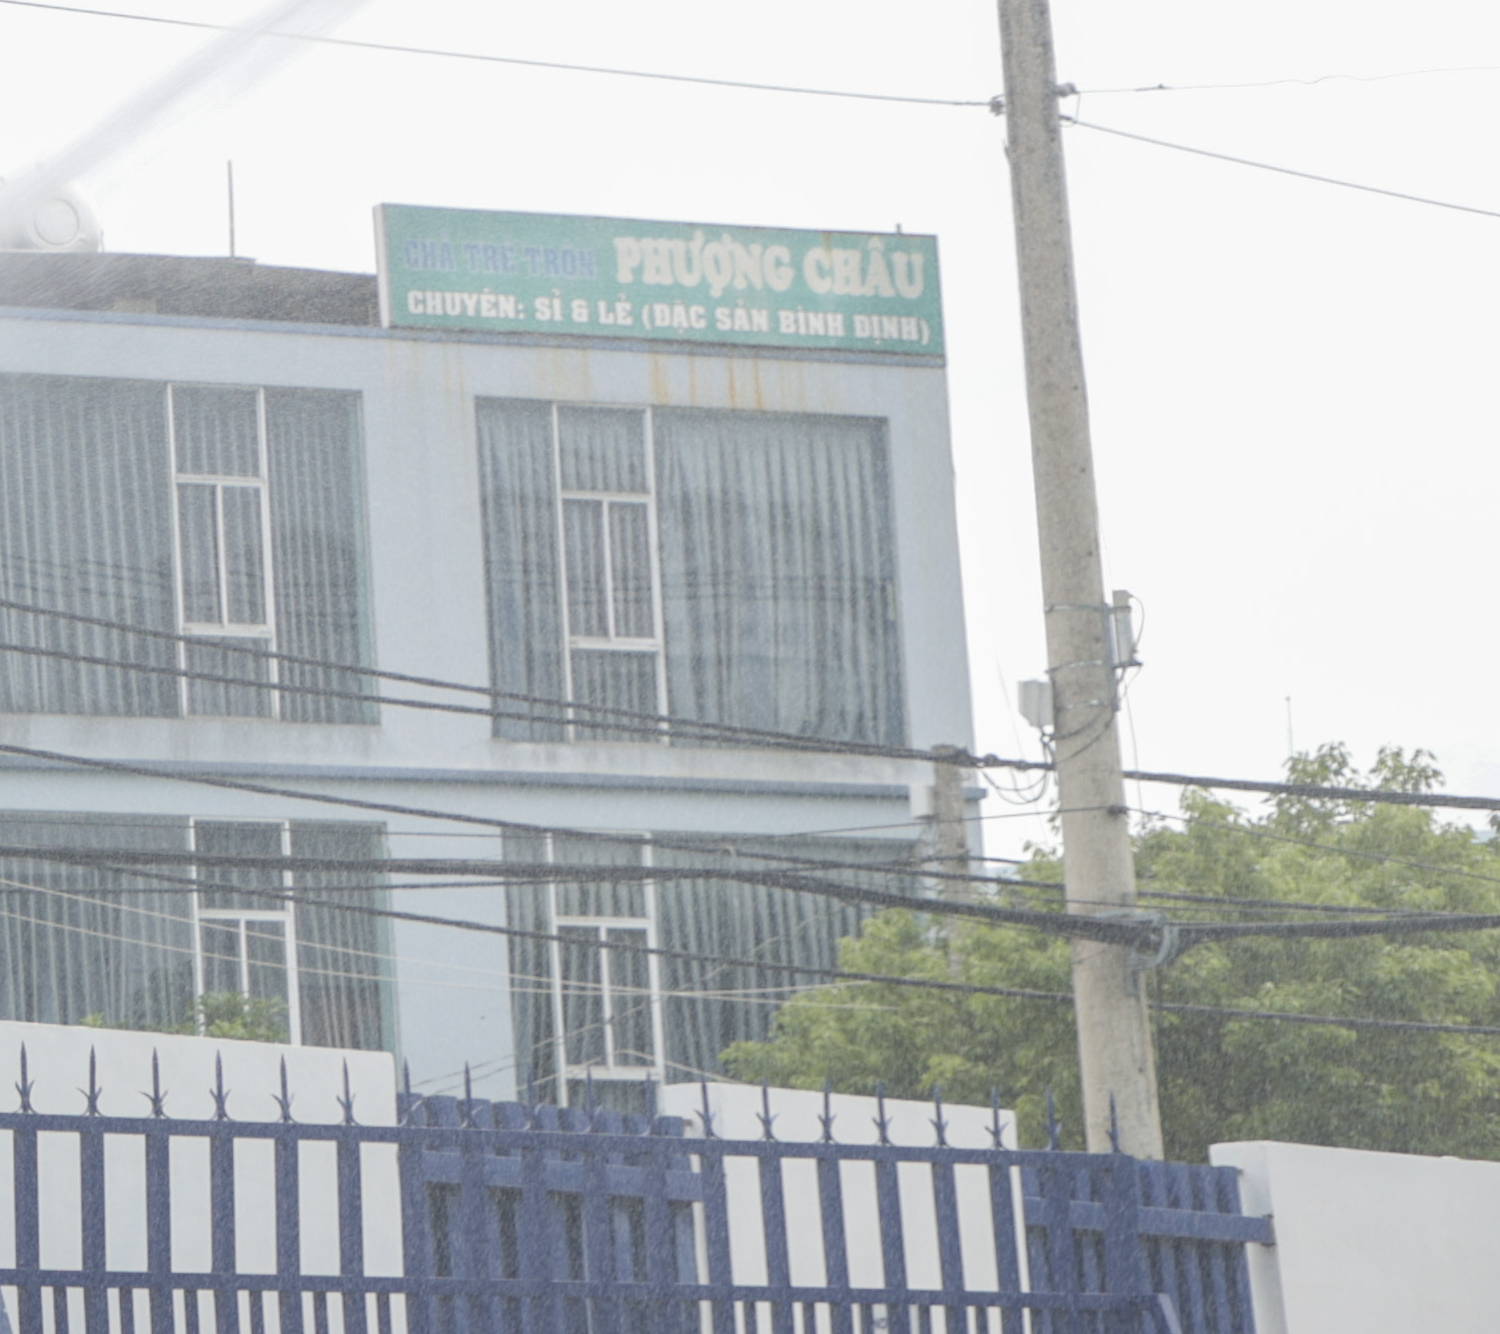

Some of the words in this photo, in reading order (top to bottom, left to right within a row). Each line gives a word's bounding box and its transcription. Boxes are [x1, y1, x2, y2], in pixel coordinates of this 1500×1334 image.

[613, 230, 795, 298] PHƯỢNG
[804, 236, 925, 299] CHÂU
[407, 287, 526, 320] CHUYÊN:
[534, 288, 564, 322] SỈ
[571, 298, 590, 323] &
[597, 292, 634, 327] LẺ
[714, 298, 770, 333] SẢN
[777, 305, 846, 338] BÌNH
